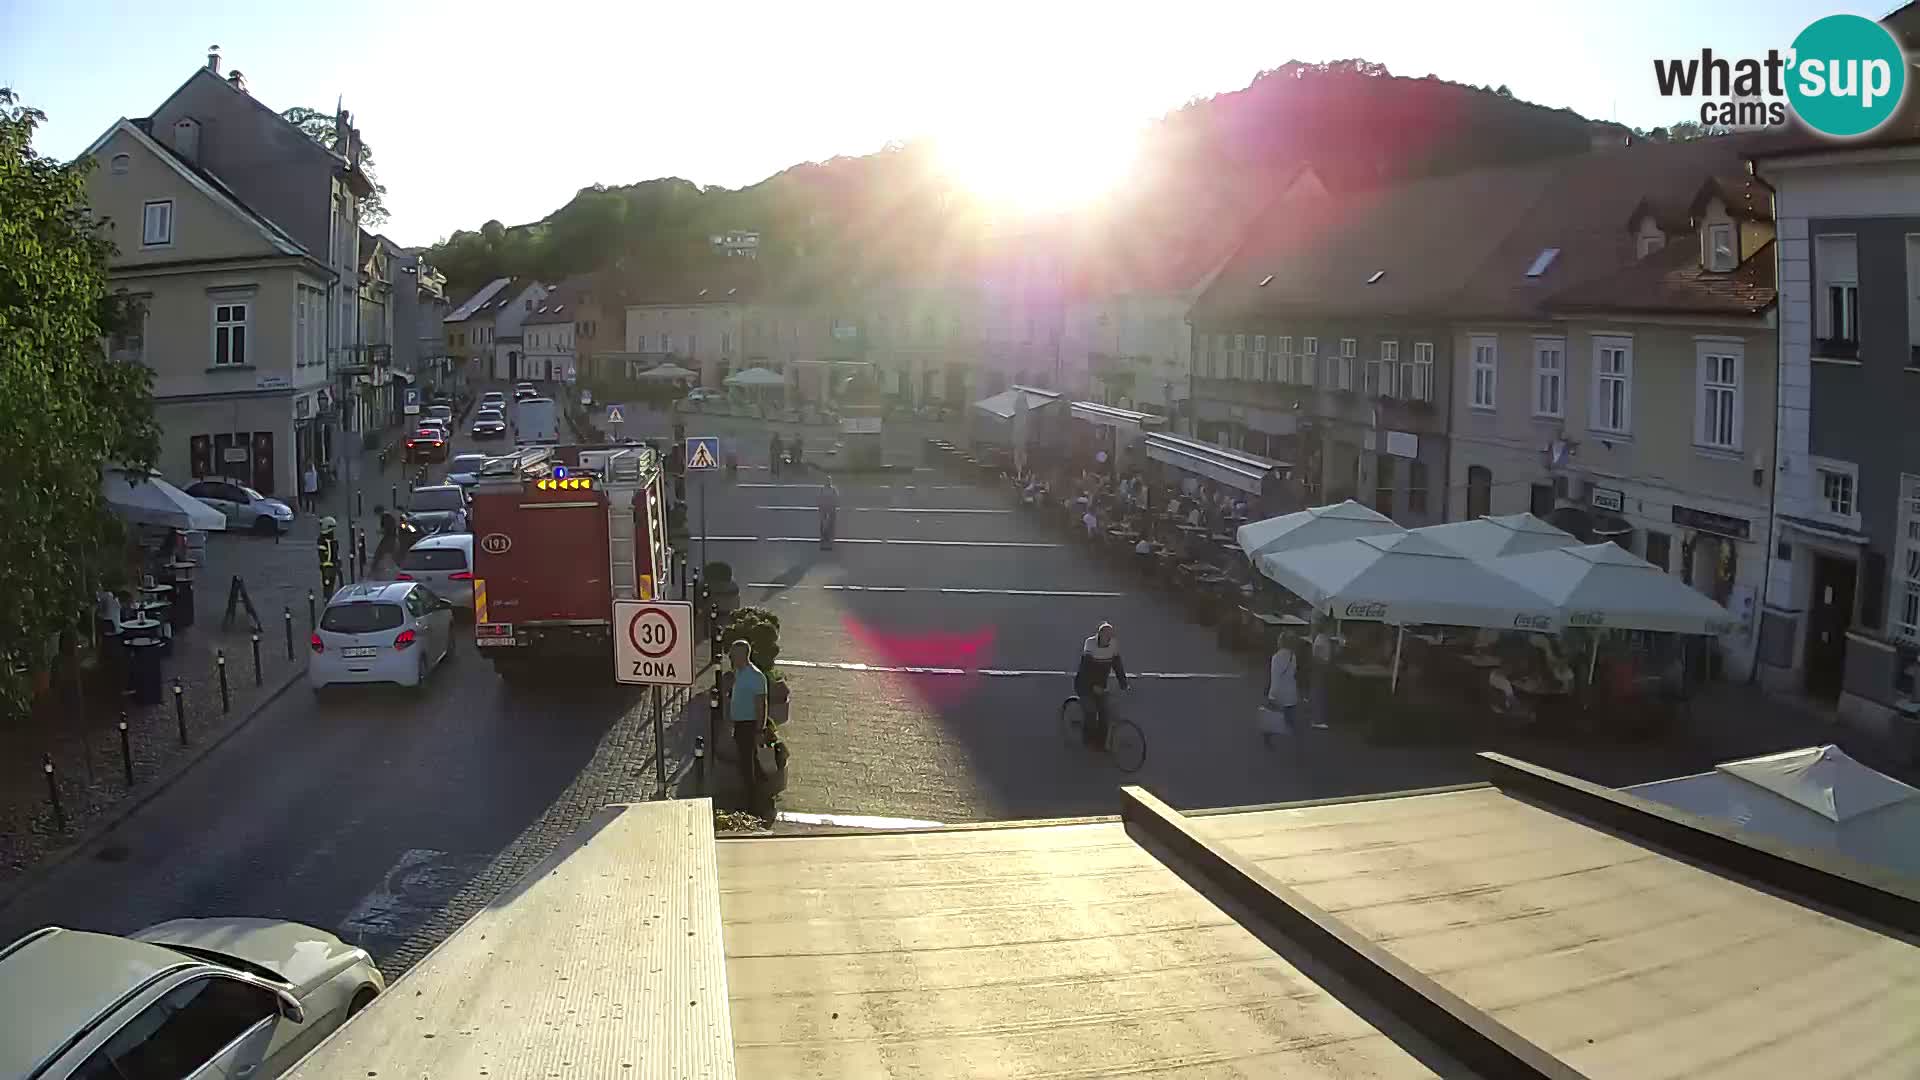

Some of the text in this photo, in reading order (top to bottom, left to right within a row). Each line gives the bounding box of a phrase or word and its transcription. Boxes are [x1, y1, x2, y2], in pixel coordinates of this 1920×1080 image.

[408, 391, 416, 403] P
[488, 539, 507, 550] 193
[641, 623, 666, 645] 30
[632, 661, 677, 678] ZONA
